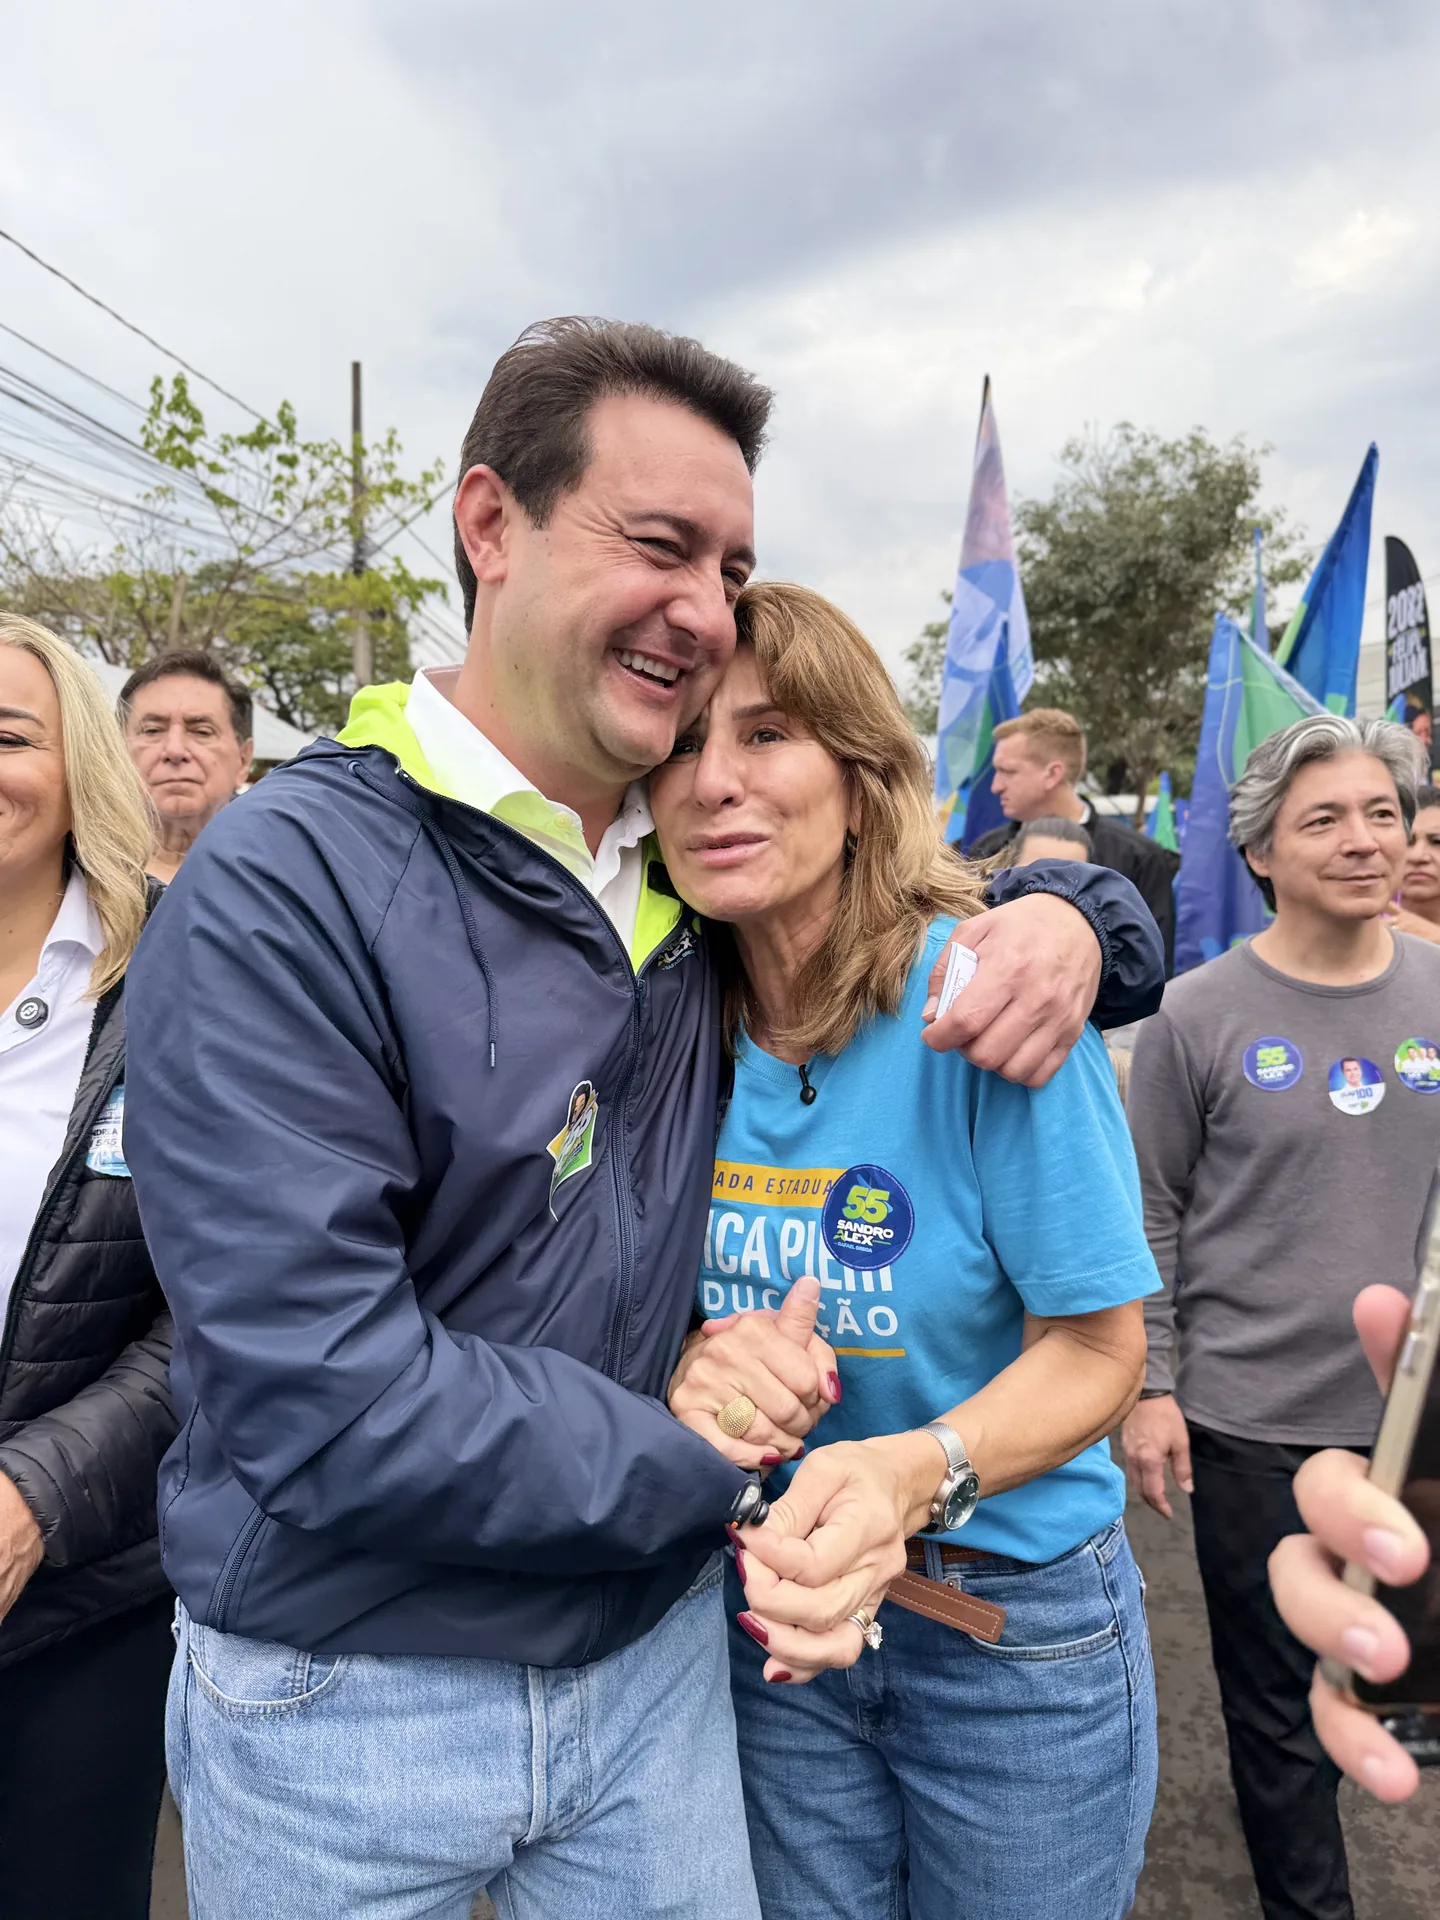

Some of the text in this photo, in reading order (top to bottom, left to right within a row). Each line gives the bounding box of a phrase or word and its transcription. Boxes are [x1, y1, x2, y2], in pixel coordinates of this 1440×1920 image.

[714, 1171, 834, 1195] ADA ESTADUA
[842, 1185, 890, 1223] 55
[703, 1209, 770, 1279] ICA
[833, 1229, 873, 1246] ALEX
[836, 1219, 894, 1240] SANDRO
[703, 1280, 899, 1338] DUCÇÃO
